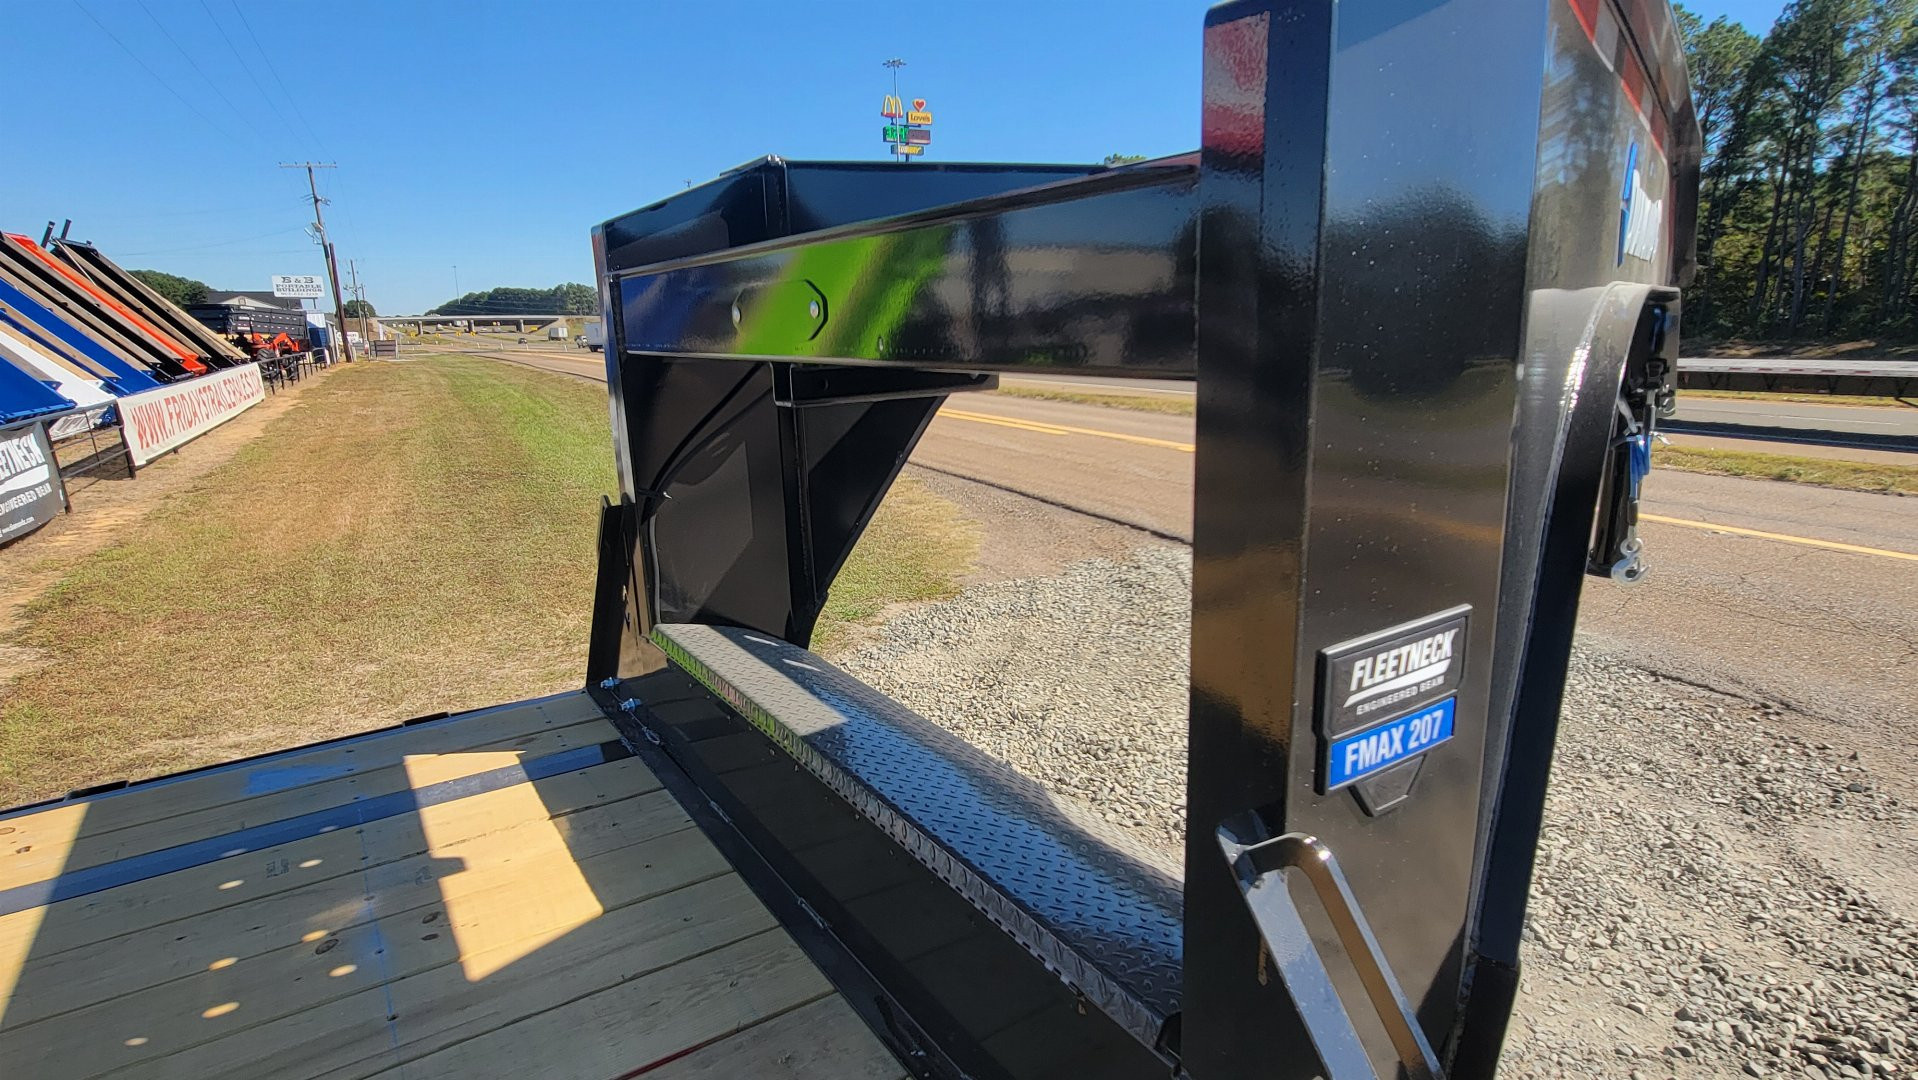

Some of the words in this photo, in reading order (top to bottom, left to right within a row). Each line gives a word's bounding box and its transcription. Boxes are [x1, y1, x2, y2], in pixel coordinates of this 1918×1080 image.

[281, 276, 292, 284] B
[303, 276, 314, 284] B
[1349, 628, 1459, 692] FLEETNECK
[1356, 686, 1419, 716] ENGINEERED
[1419, 675, 1445, 693] BEAM
[1344, 724, 1404, 776] FMAX
[1408, 709, 1444, 750] 207
